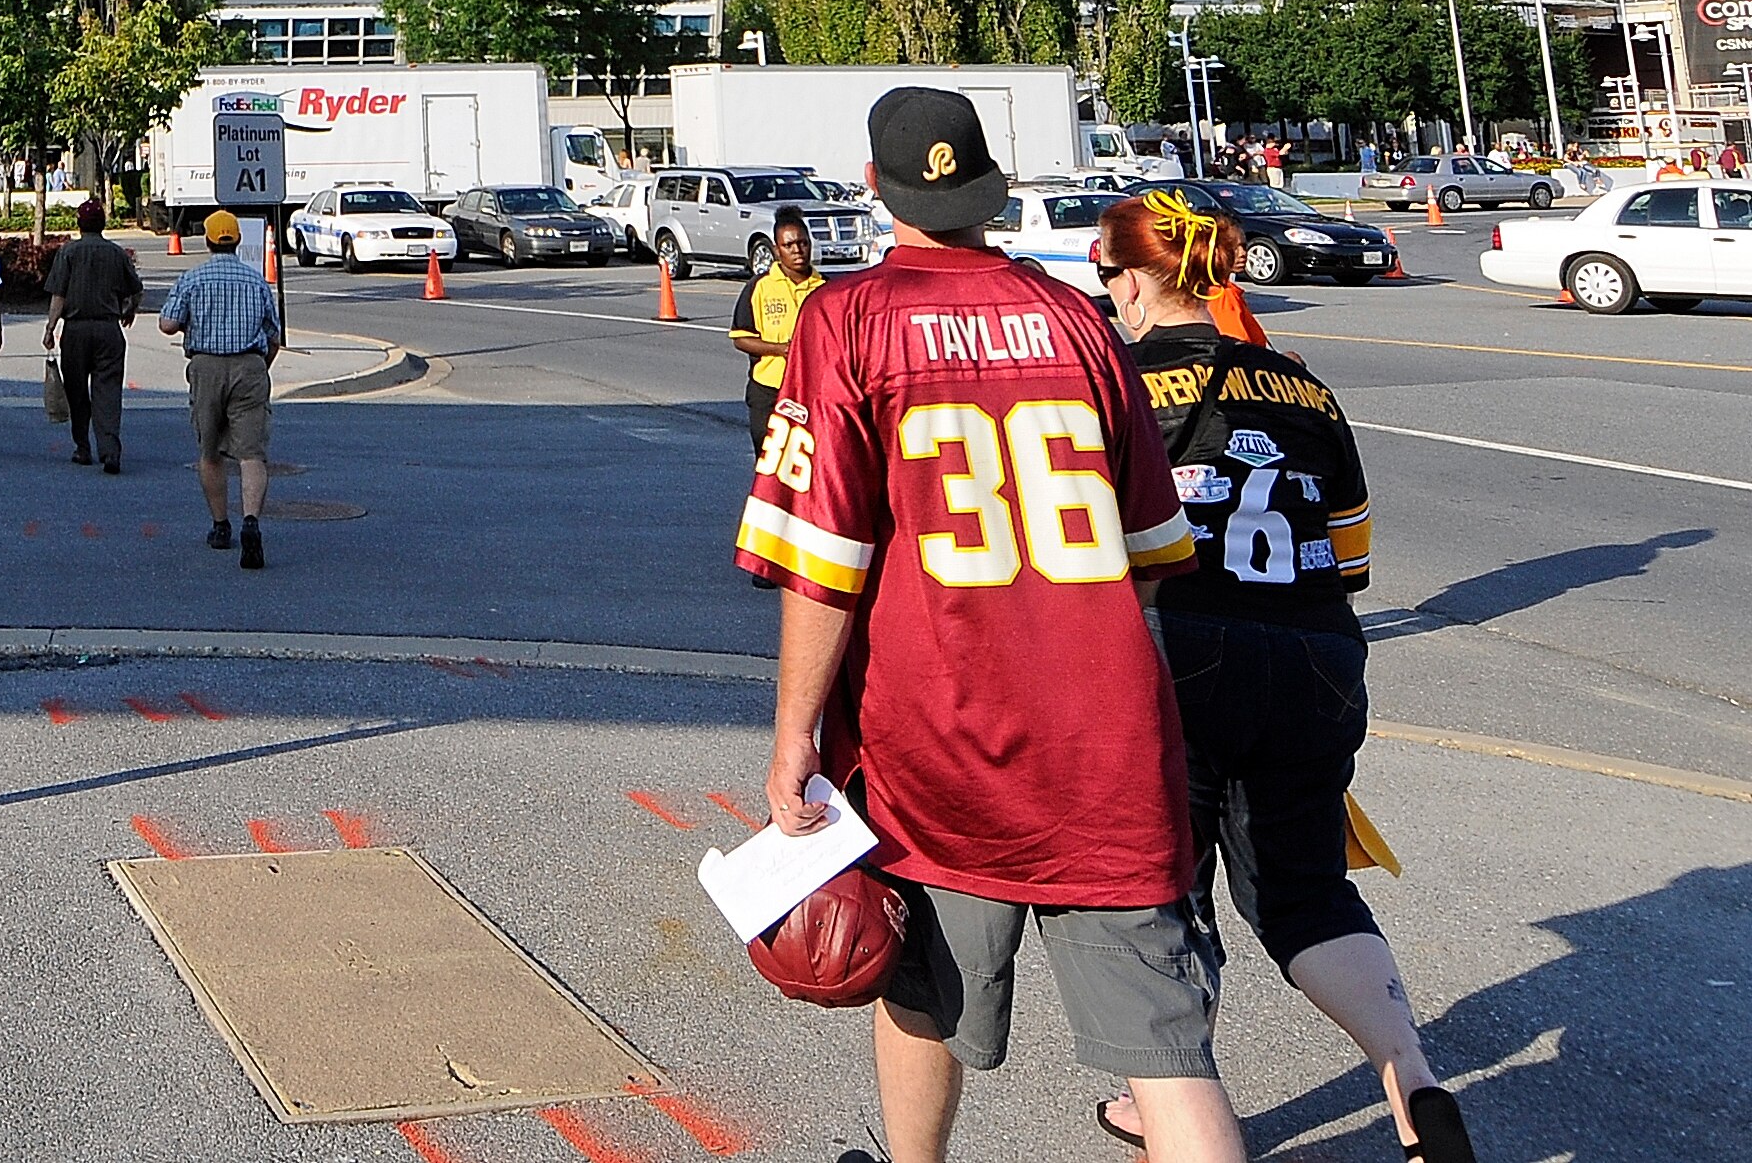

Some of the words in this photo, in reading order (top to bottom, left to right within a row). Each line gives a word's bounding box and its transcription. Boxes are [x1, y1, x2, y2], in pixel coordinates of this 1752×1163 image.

[218, 97, 278, 112] FedExField
[298, 87, 407, 122] Ryder
[218, 124, 281, 142] Platinum
[237, 146, 260, 162] Lot
[235, 168, 267, 192] A1
[910, 312, 1057, 362] TAYLOR
[1141, 367, 1202, 410] UPER
[1254, 369, 1339, 422] CHAMPS
[754, 413, 815, 494] 36
[898, 399, 1131, 587] 36
[1224, 468, 1296, 584] 6
